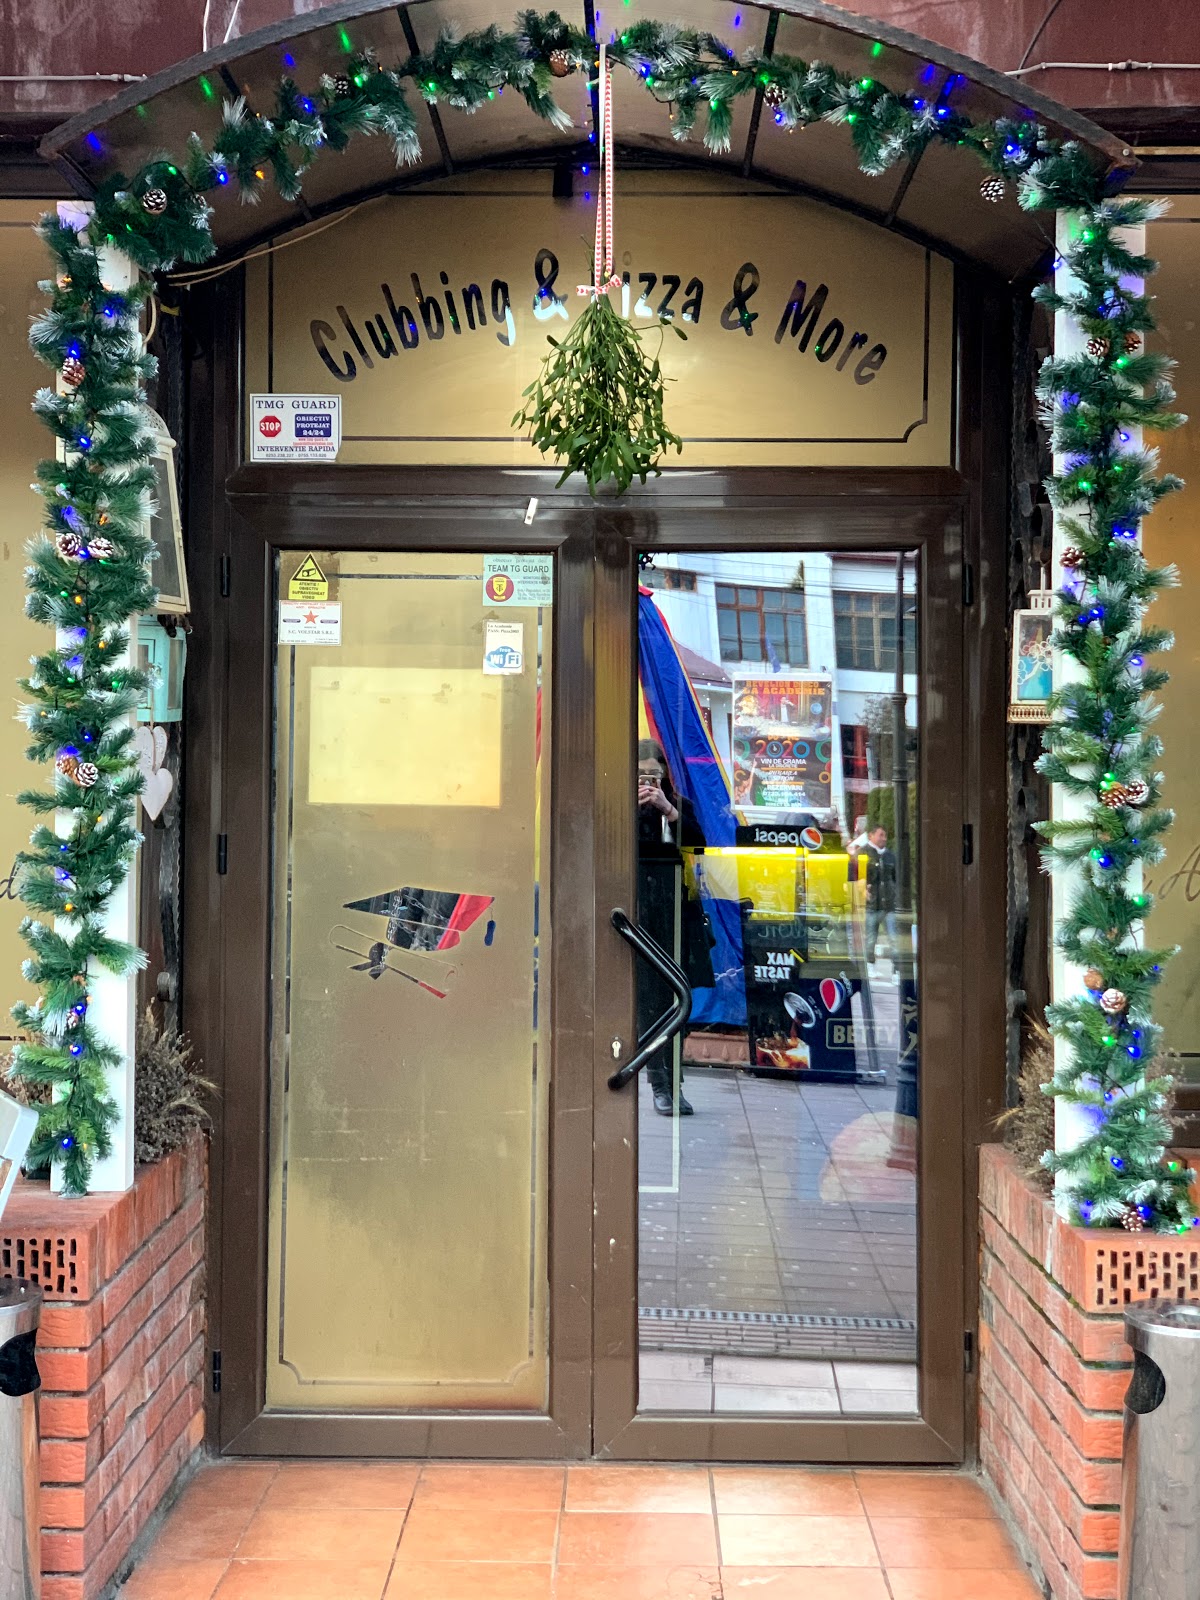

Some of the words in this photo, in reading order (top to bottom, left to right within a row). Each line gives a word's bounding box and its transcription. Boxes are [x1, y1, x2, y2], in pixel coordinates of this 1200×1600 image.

[310, 271, 516, 383] Clubbing
[532, 248, 569, 322] &
[592, 248, 704, 324] izza
[720, 262, 762, 337] &
[775, 280, 888, 386] More
[256, 400, 284, 409] TMG
[291, 400, 336, 409] GUARD
[260, 422, 280, 431] STOP
[488, 564, 508, 572] TEAM
[510, 565, 521, 573] TG
[522, 565, 549, 573] GUARD
[490, 654, 503, 665] Wi
[508, 655, 519, 665] Fi
[763, 687, 825, 695] ACADEMIE
[755, 740, 810, 758] 2020
[833, 1024, 897, 1044] BETTY
